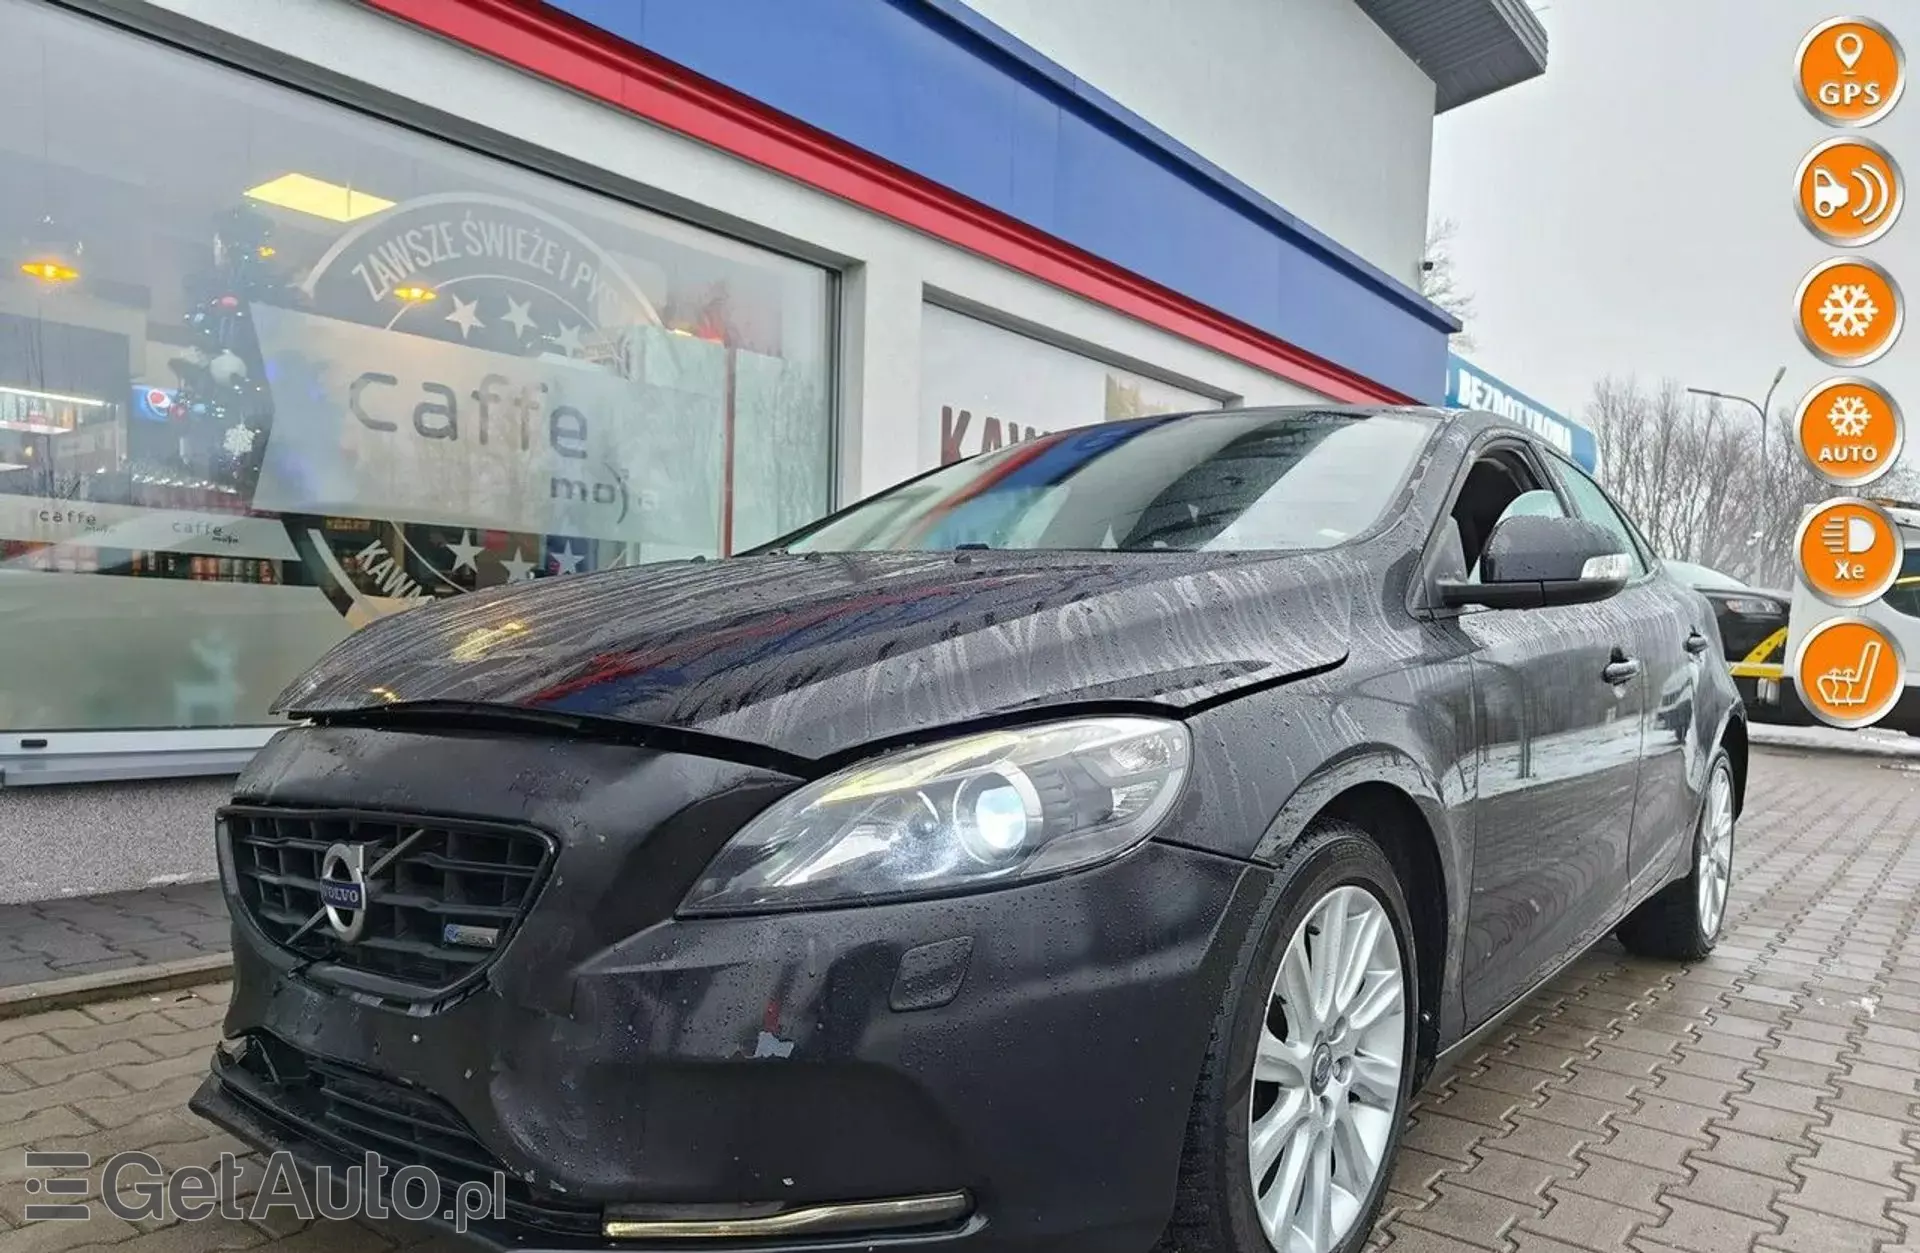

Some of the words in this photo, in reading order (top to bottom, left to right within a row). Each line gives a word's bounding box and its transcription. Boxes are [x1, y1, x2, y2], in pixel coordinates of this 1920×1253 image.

[351, 221, 461, 302] ZAWSZE
[460, 210, 555, 276] ŚWIEŻE
[349, 372, 587, 458] caffe
[39, 509, 97, 526] caffe
[172, 521, 223, 536] caffe
[321, 885, 359, 903] VOLVO
